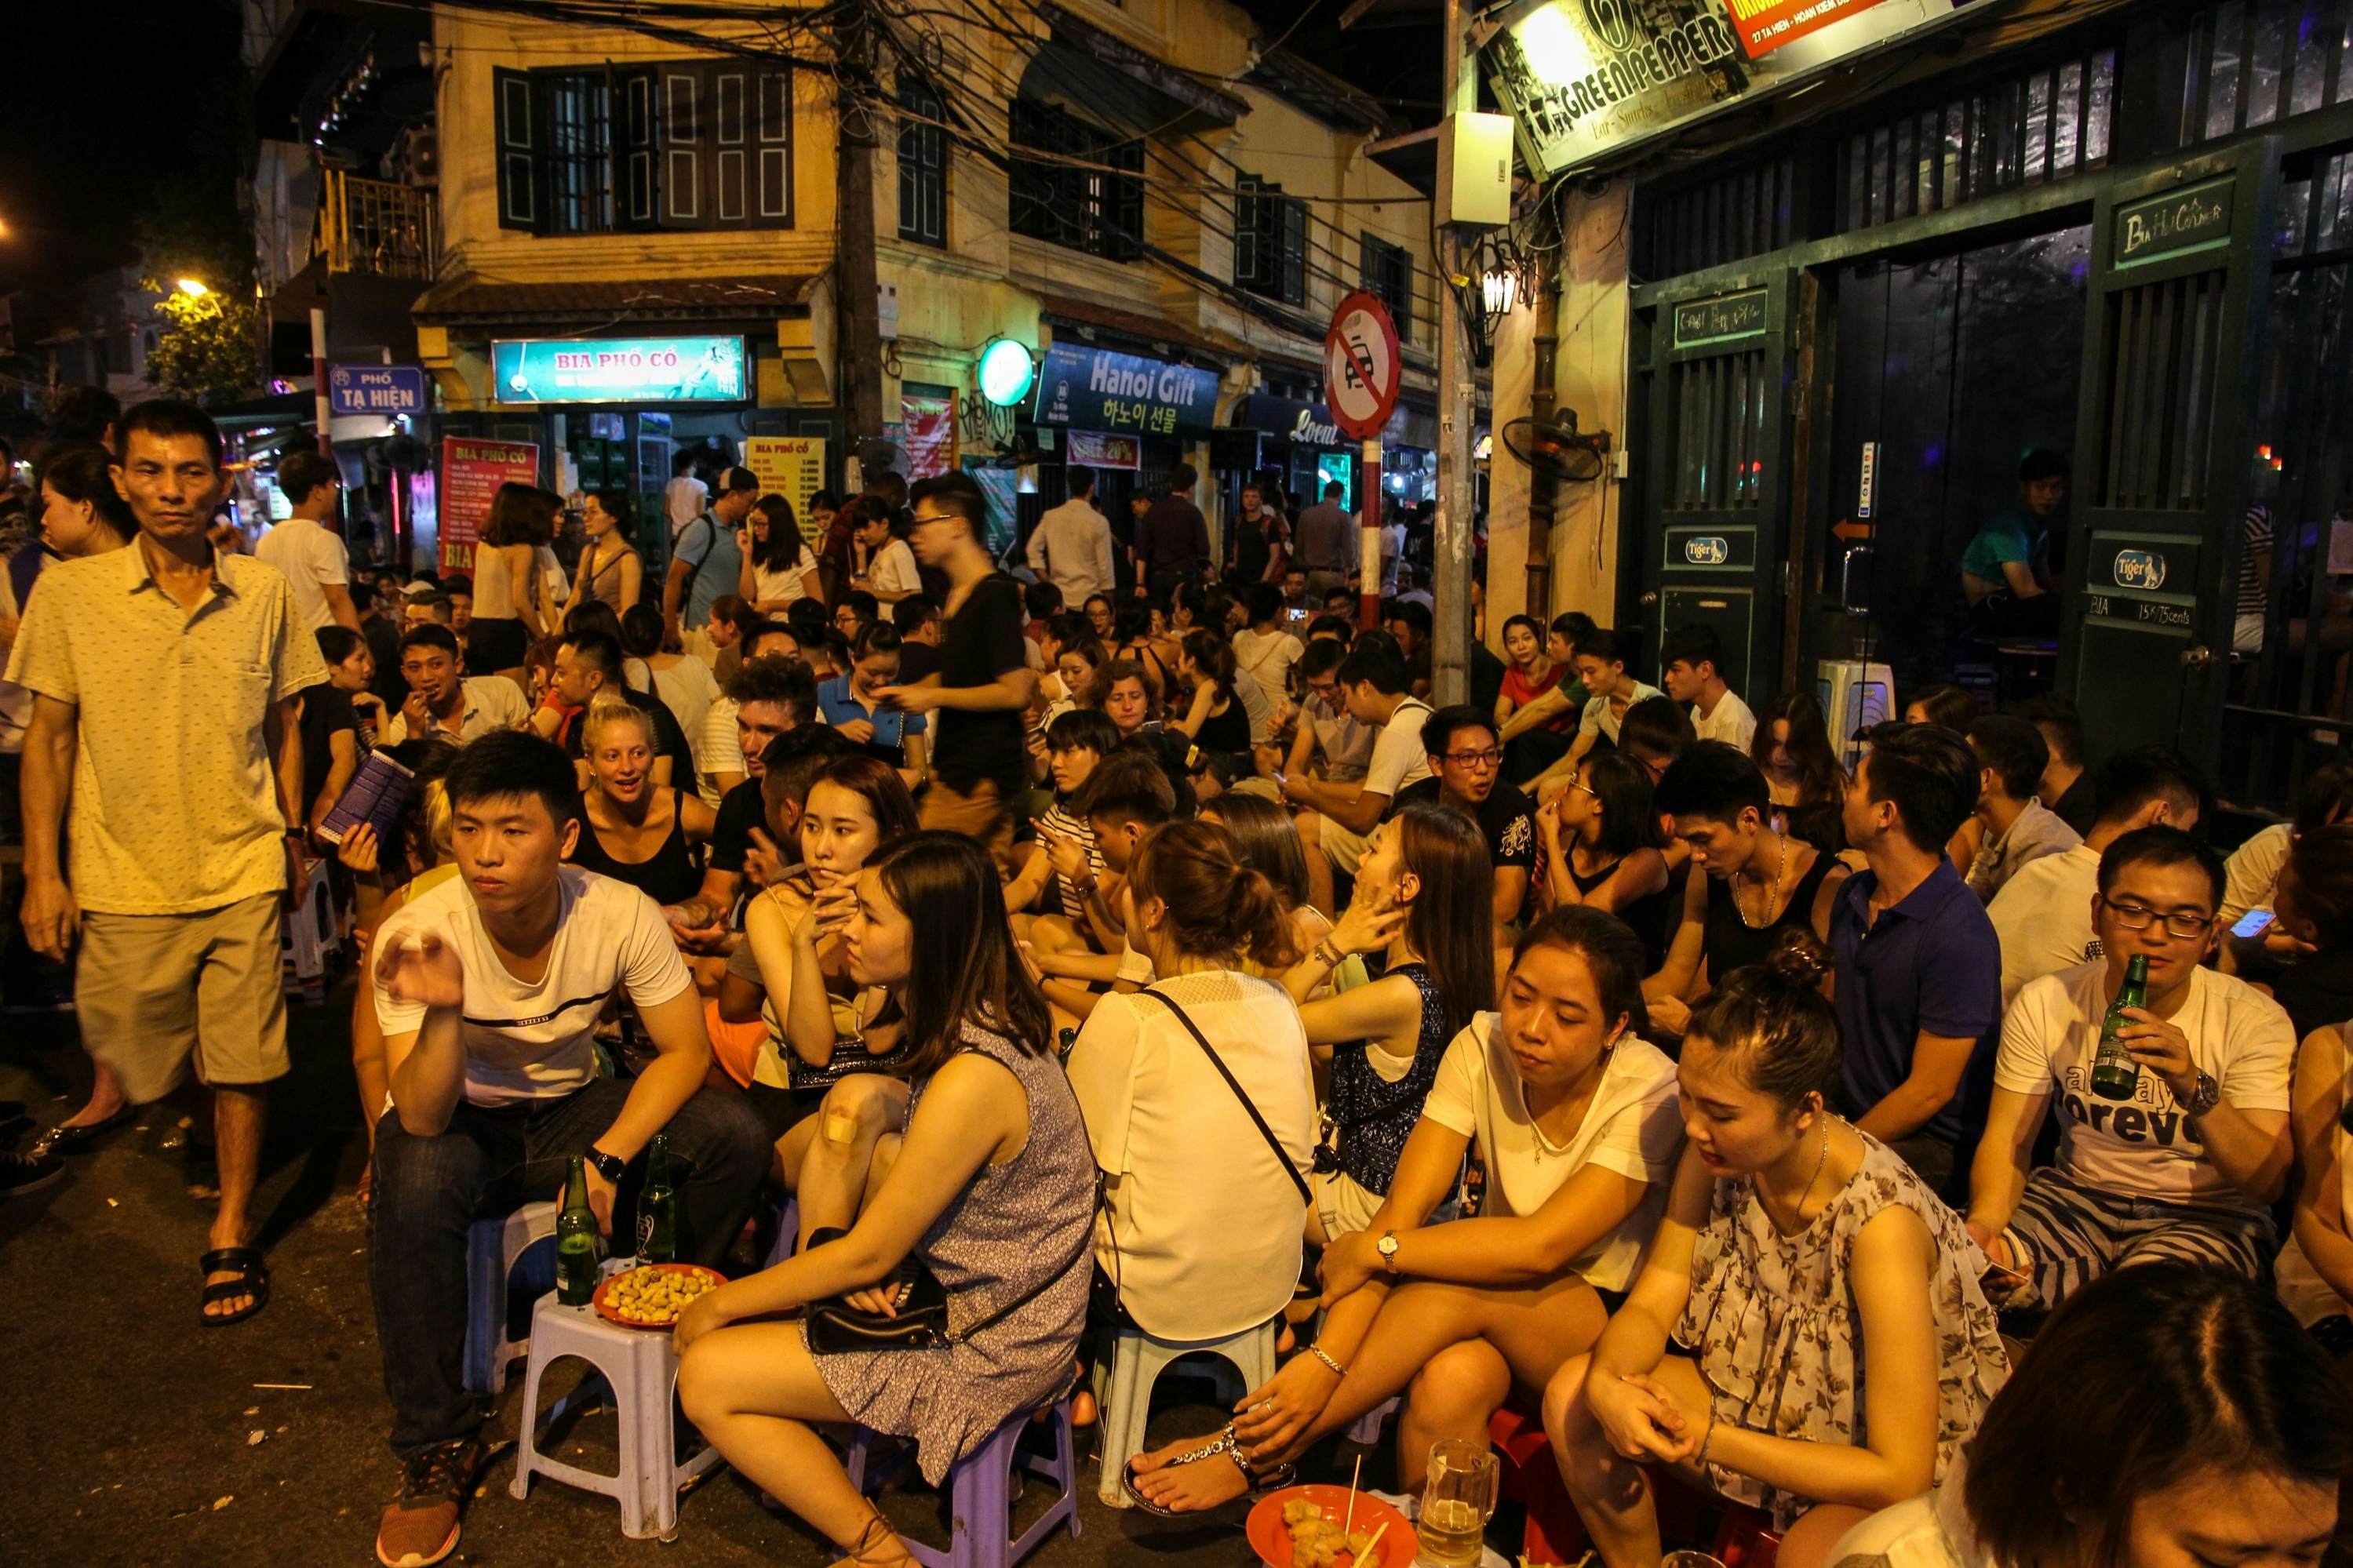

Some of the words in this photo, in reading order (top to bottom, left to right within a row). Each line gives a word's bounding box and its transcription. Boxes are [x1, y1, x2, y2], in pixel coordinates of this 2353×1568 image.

[1752, 31, 1761, 44] 27
[556, 355, 592, 369] BIA
[361, 370, 392, 384] PHỐ
[1090, 355, 1156, 400] Hanoi
[1158, 367, 1197, 406] Gift
[342, 389, 366, 410] TẠ
[370, 385, 414, 410] HIỆN
[1103, 398, 1147, 431] 하노이
[1150, 406, 1177, 434] 선물
[456, 446, 478, 460] BIA
[1074, 438, 1105, 459] SALE
[1106, 440, 1133, 462] 20%
[445, 543, 473, 569] BIA
[1689, 543, 1711, 558] Tiger
[2119, 558, 2145, 580] Tiger
[2089, 595, 2109, 615] BIA
